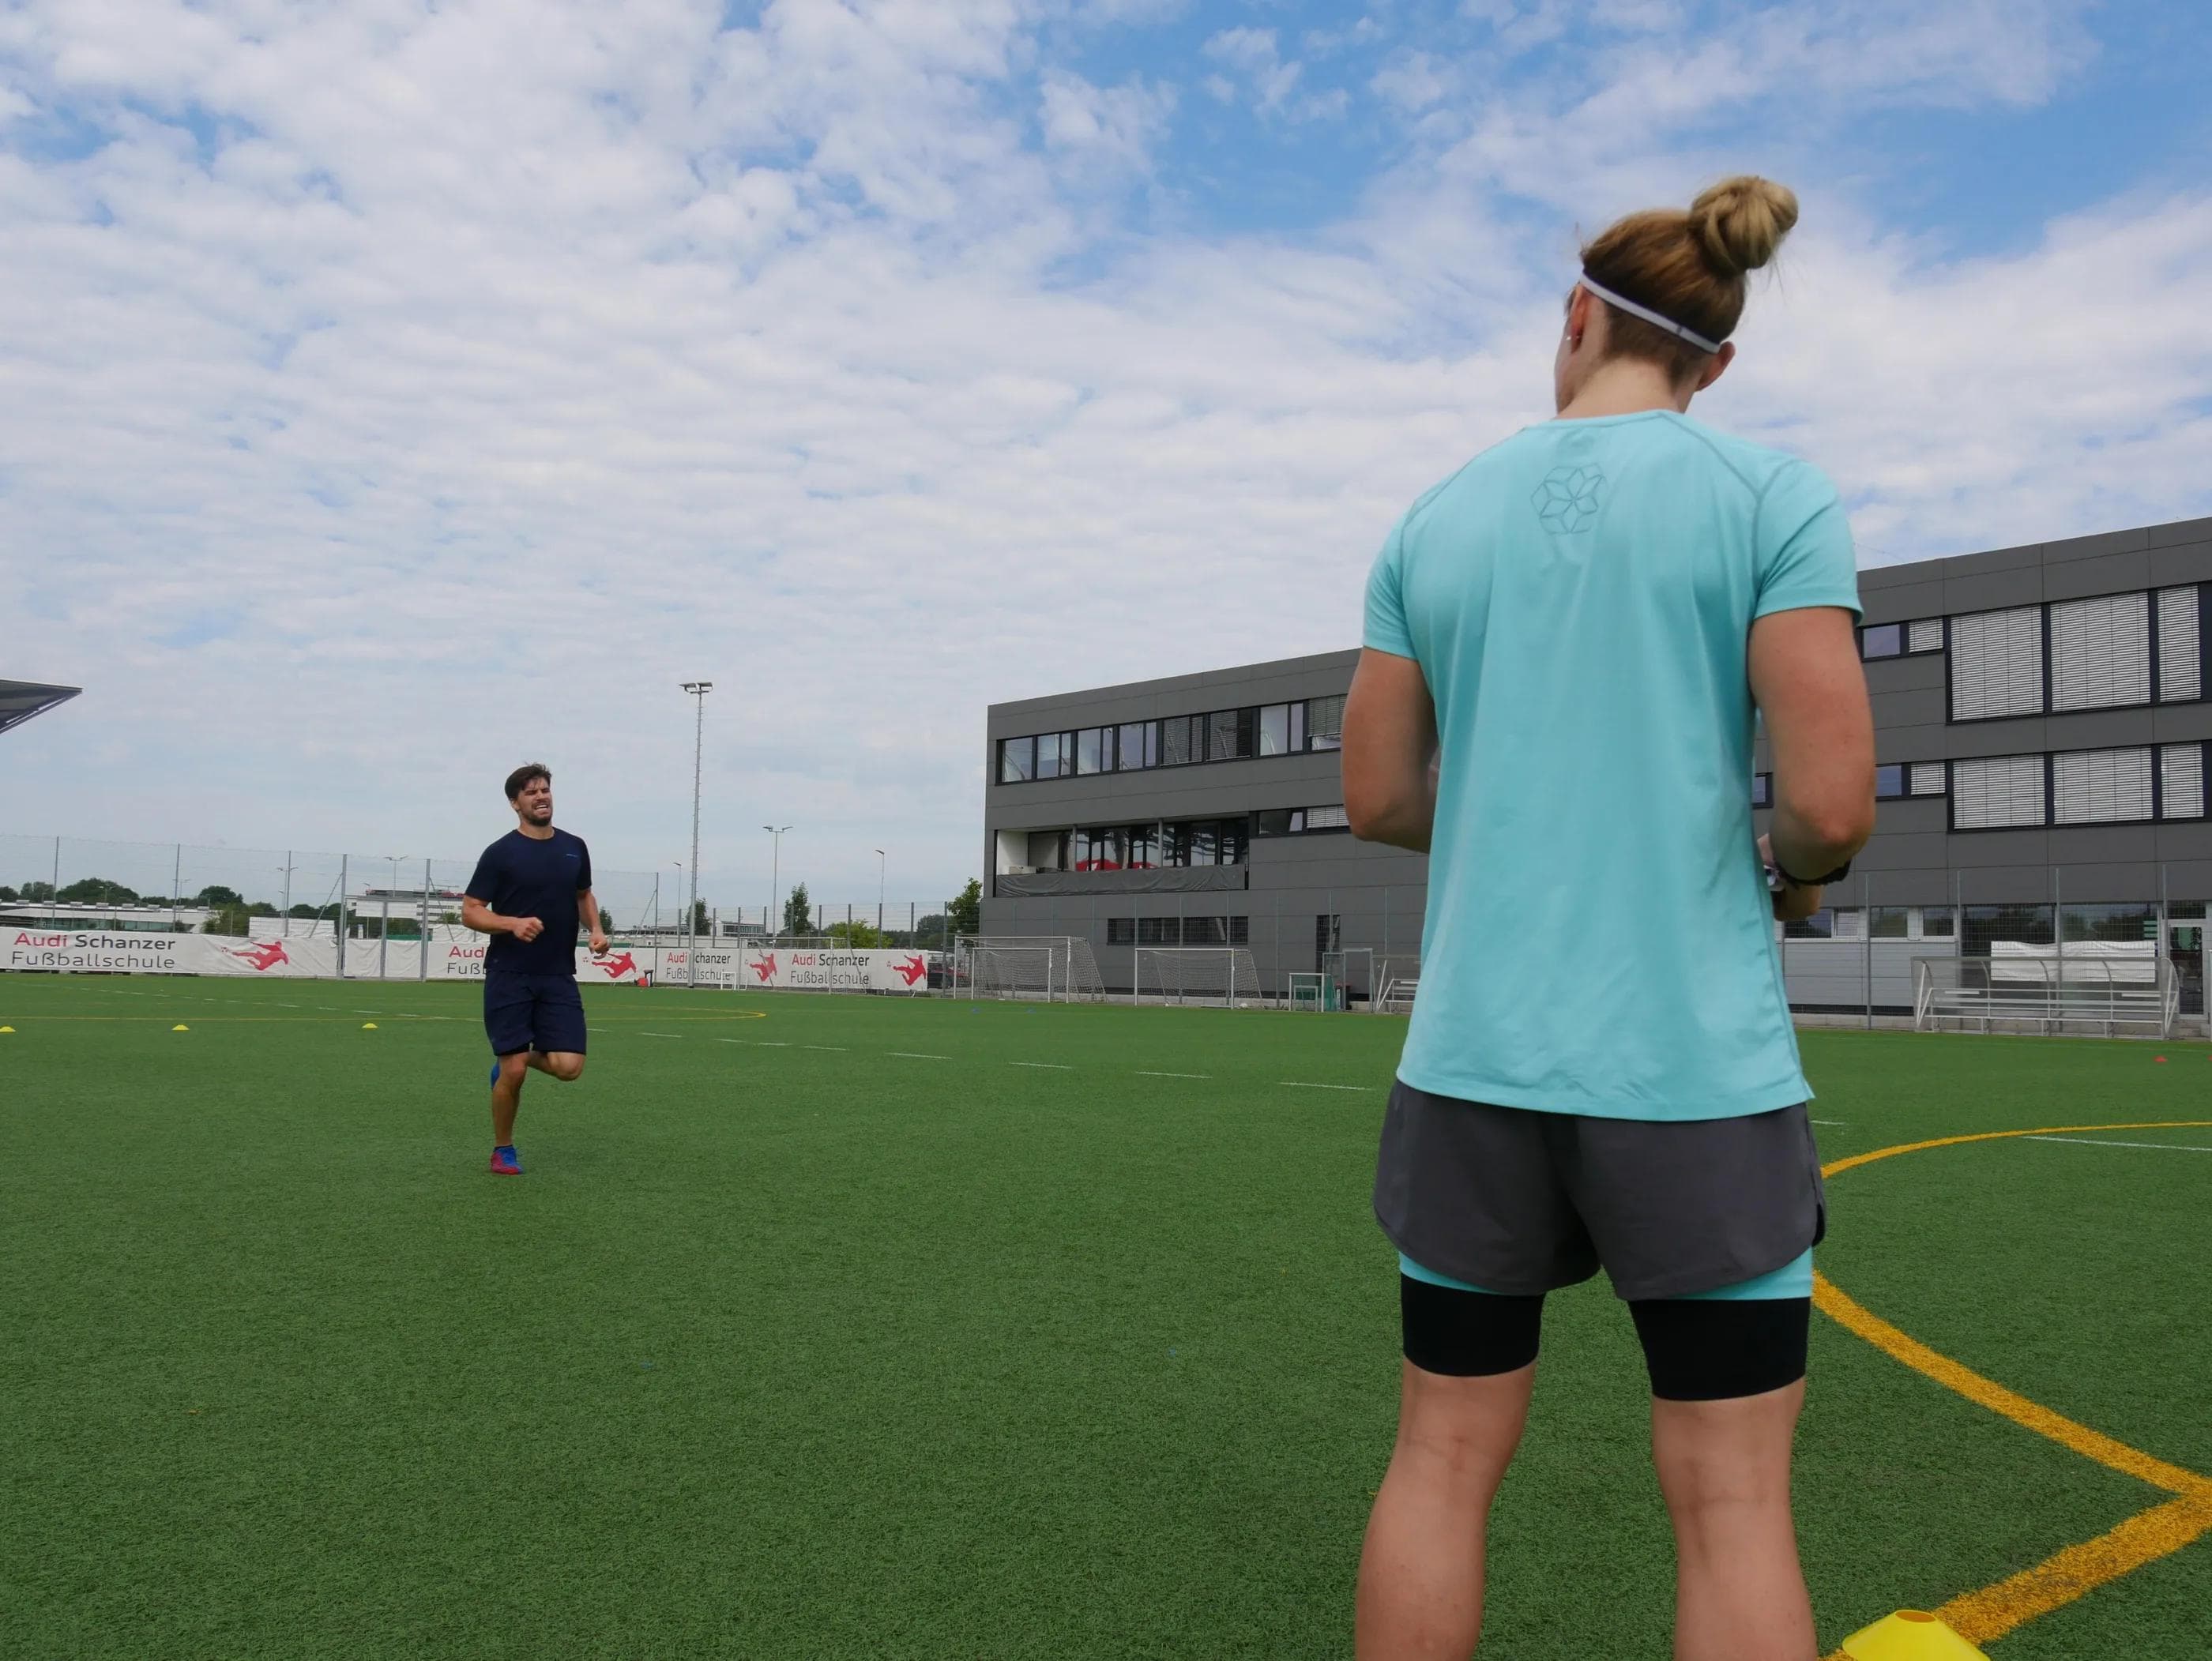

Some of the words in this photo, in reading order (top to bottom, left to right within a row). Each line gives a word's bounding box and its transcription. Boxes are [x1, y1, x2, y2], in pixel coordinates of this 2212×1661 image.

[13, 932, 69, 947] Audi
[74, 934, 176, 950] Schanzer
[448, 945, 484, 958] Aud
[667, 951, 687, 964] Audi
[690, 952, 732, 964] chanzer
[11, 951, 175, 969] Fußballschule
[791, 953, 816, 966] Audi
[818, 953, 870, 967] Schanzer
[666, 967, 731, 981] Fußbllschule
[790, 970, 870, 985] Fußbalschule
